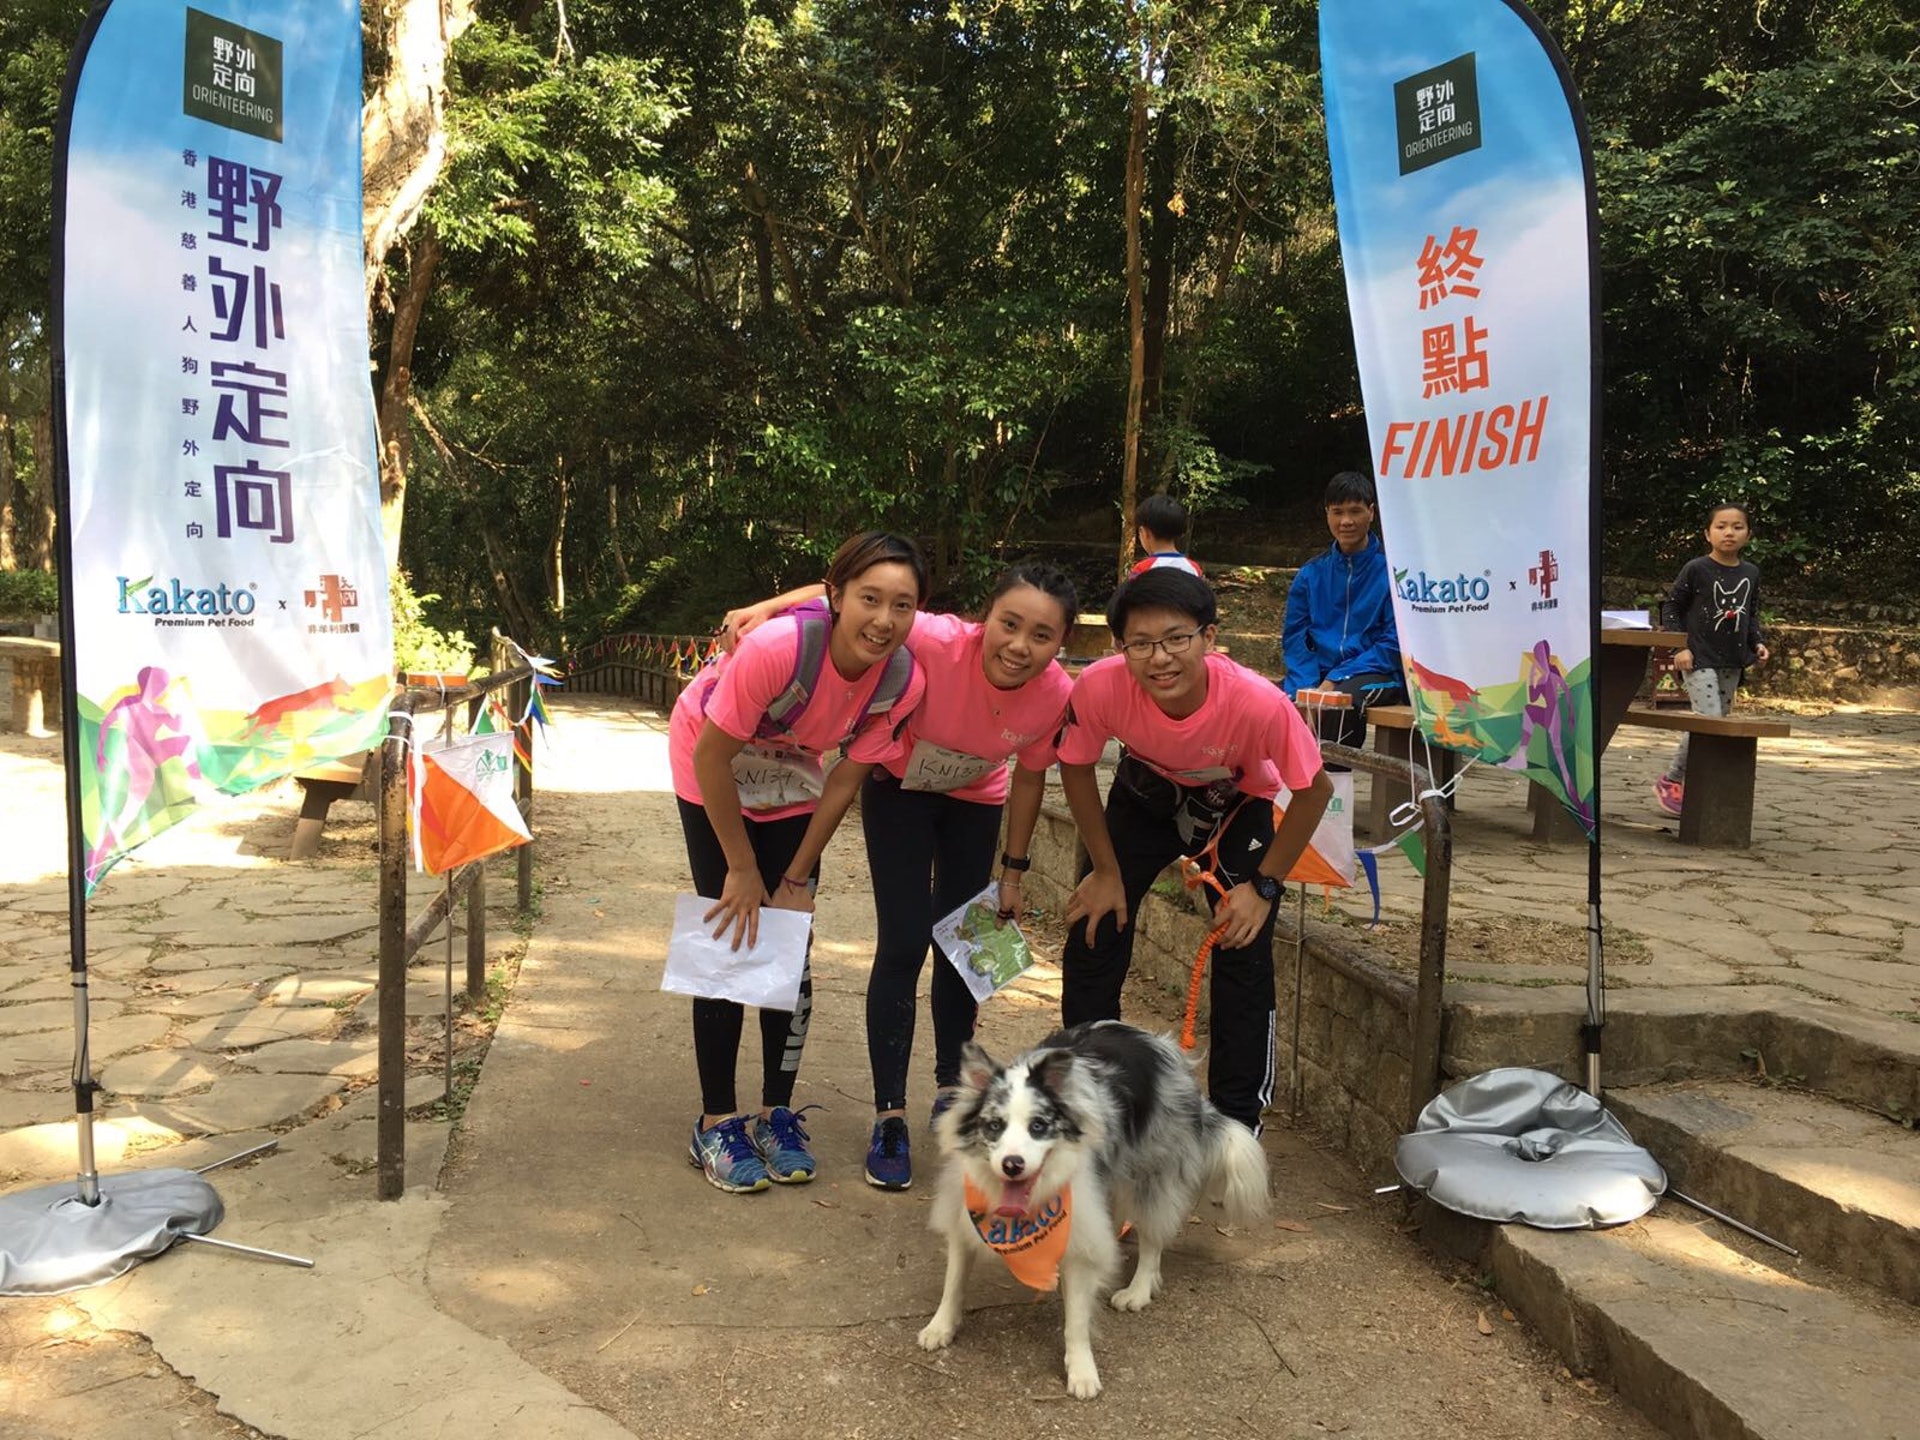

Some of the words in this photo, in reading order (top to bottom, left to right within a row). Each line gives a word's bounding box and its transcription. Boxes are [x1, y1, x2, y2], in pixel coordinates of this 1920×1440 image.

[213, 35, 256, 71] 野外
[213, 63, 256, 98] 定向
[1416, 79, 1455, 112] 野外
[192, 84, 274, 124] ORIENTEERING
[1418, 102, 1456, 135] 定向
[1405, 121, 1473, 158] ORIENTEERING
[1416, 226, 1489, 399] 終點
[207, 155, 294, 544] 野外定向
[1380, 395, 1549, 479] FINISH
[154, 617, 205, 627] Premium
[207, 618, 226, 627] Pet
[228, 617, 255, 627] Food
[1411, 604, 1446, 613] Premium
[1448, 605, 1464, 613] Pet
[1466, 602, 1489, 612] Food
